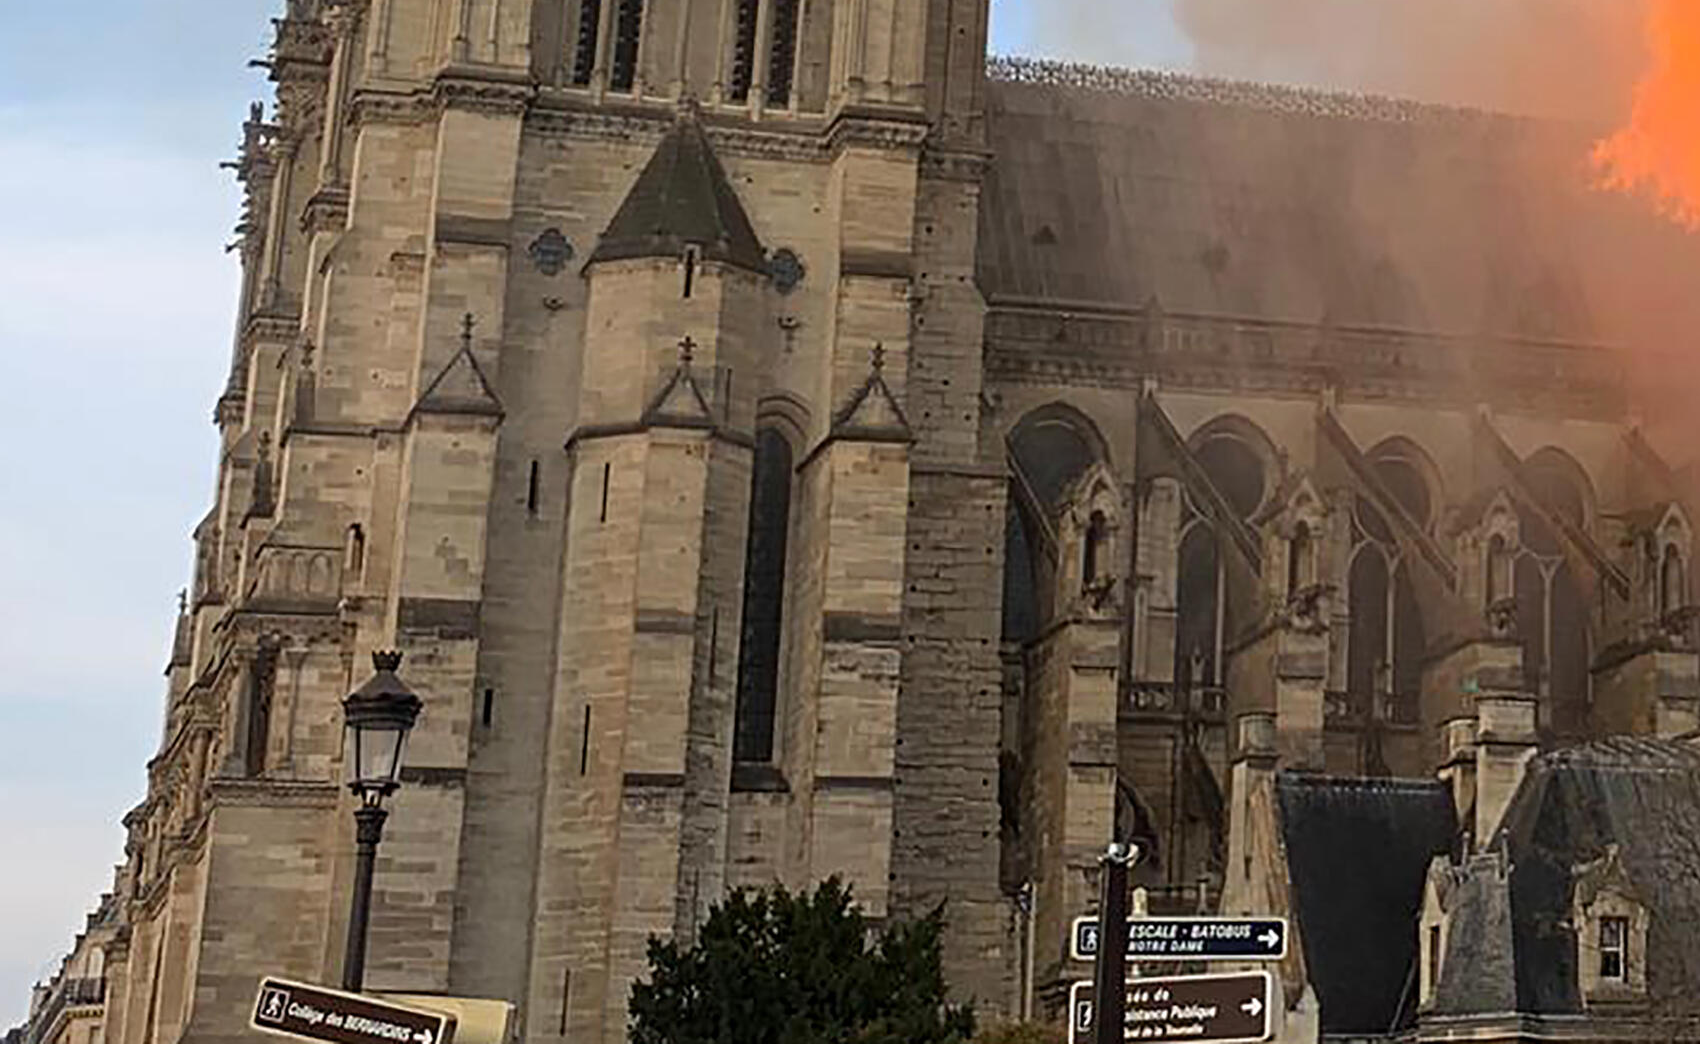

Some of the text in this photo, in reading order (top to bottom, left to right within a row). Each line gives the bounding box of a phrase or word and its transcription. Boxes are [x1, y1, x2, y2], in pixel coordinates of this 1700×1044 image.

[1129, 924, 1252, 939] ESCALE BATOBUS
[1128, 940, 1204, 952] NOTRE DAME
[1125, 989, 1149, 1004] sée
[1124, 1004, 1217, 1023] sistance Publique
